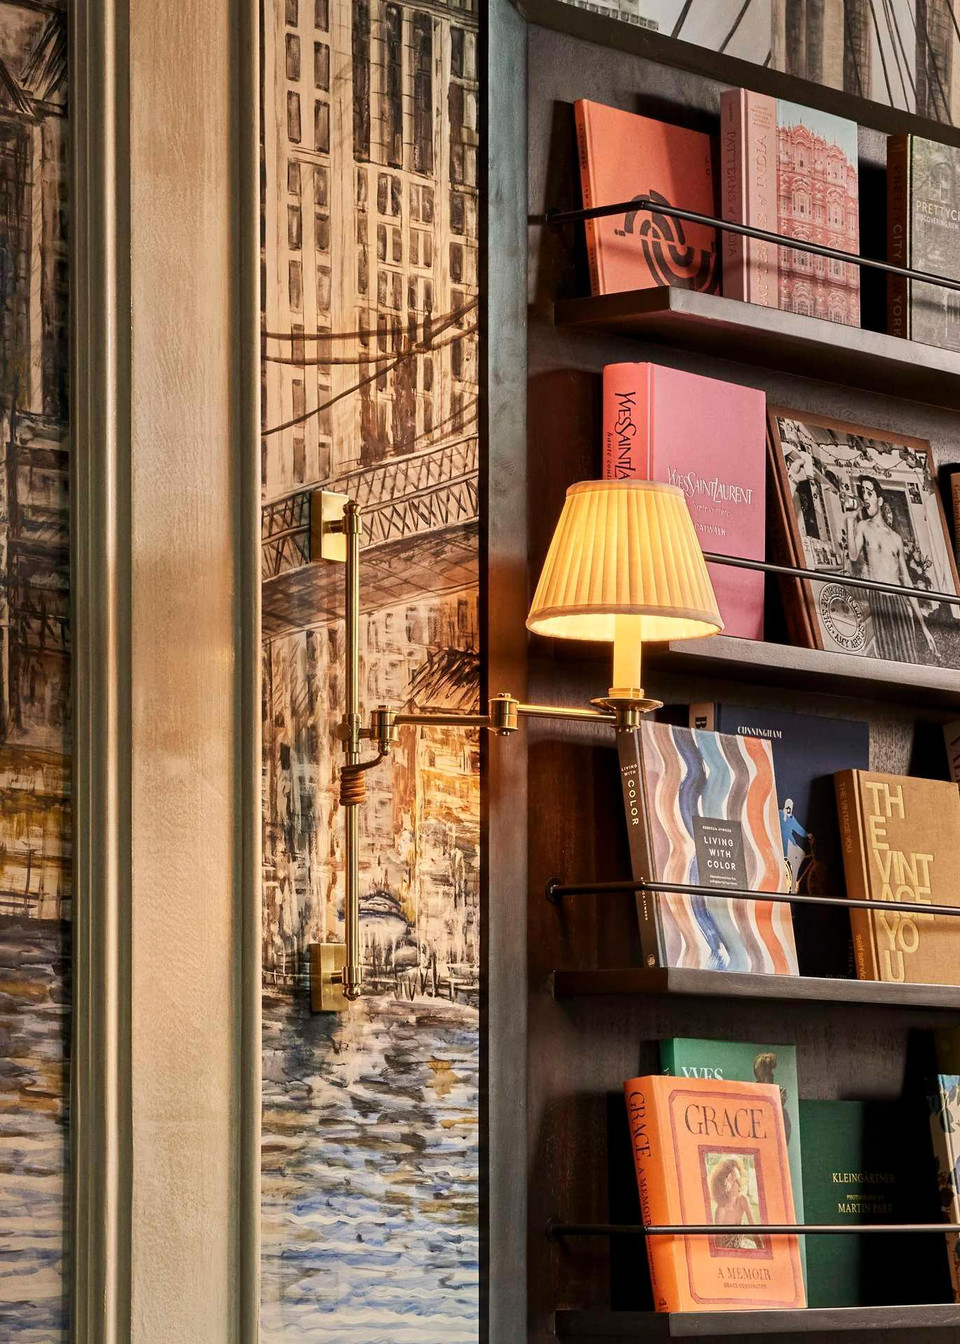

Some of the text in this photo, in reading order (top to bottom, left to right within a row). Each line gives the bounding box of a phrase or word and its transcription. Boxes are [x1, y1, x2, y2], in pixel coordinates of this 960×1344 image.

[727, 131, 737, 203] PATTERNS
[756, 134, 768, 188] INDIA
[694, 523, 728, 536] CATWALK
[737, 725, 783, 739] CUNNINGHAM
[627, 779, 639, 825] COLOR
[703, 836, 734, 847] LIVING
[708, 848, 732, 858] WITH
[706, 859, 737, 870] COLOR
[681, 1066, 724, 1080] YVES
[629, 1091, 652, 1161] GRACE
[684, 1103, 767, 1140] GRACE
[838, 1202, 871, 1214] MARTIN
[717, 1266, 772, 1281] A MEMOIR
